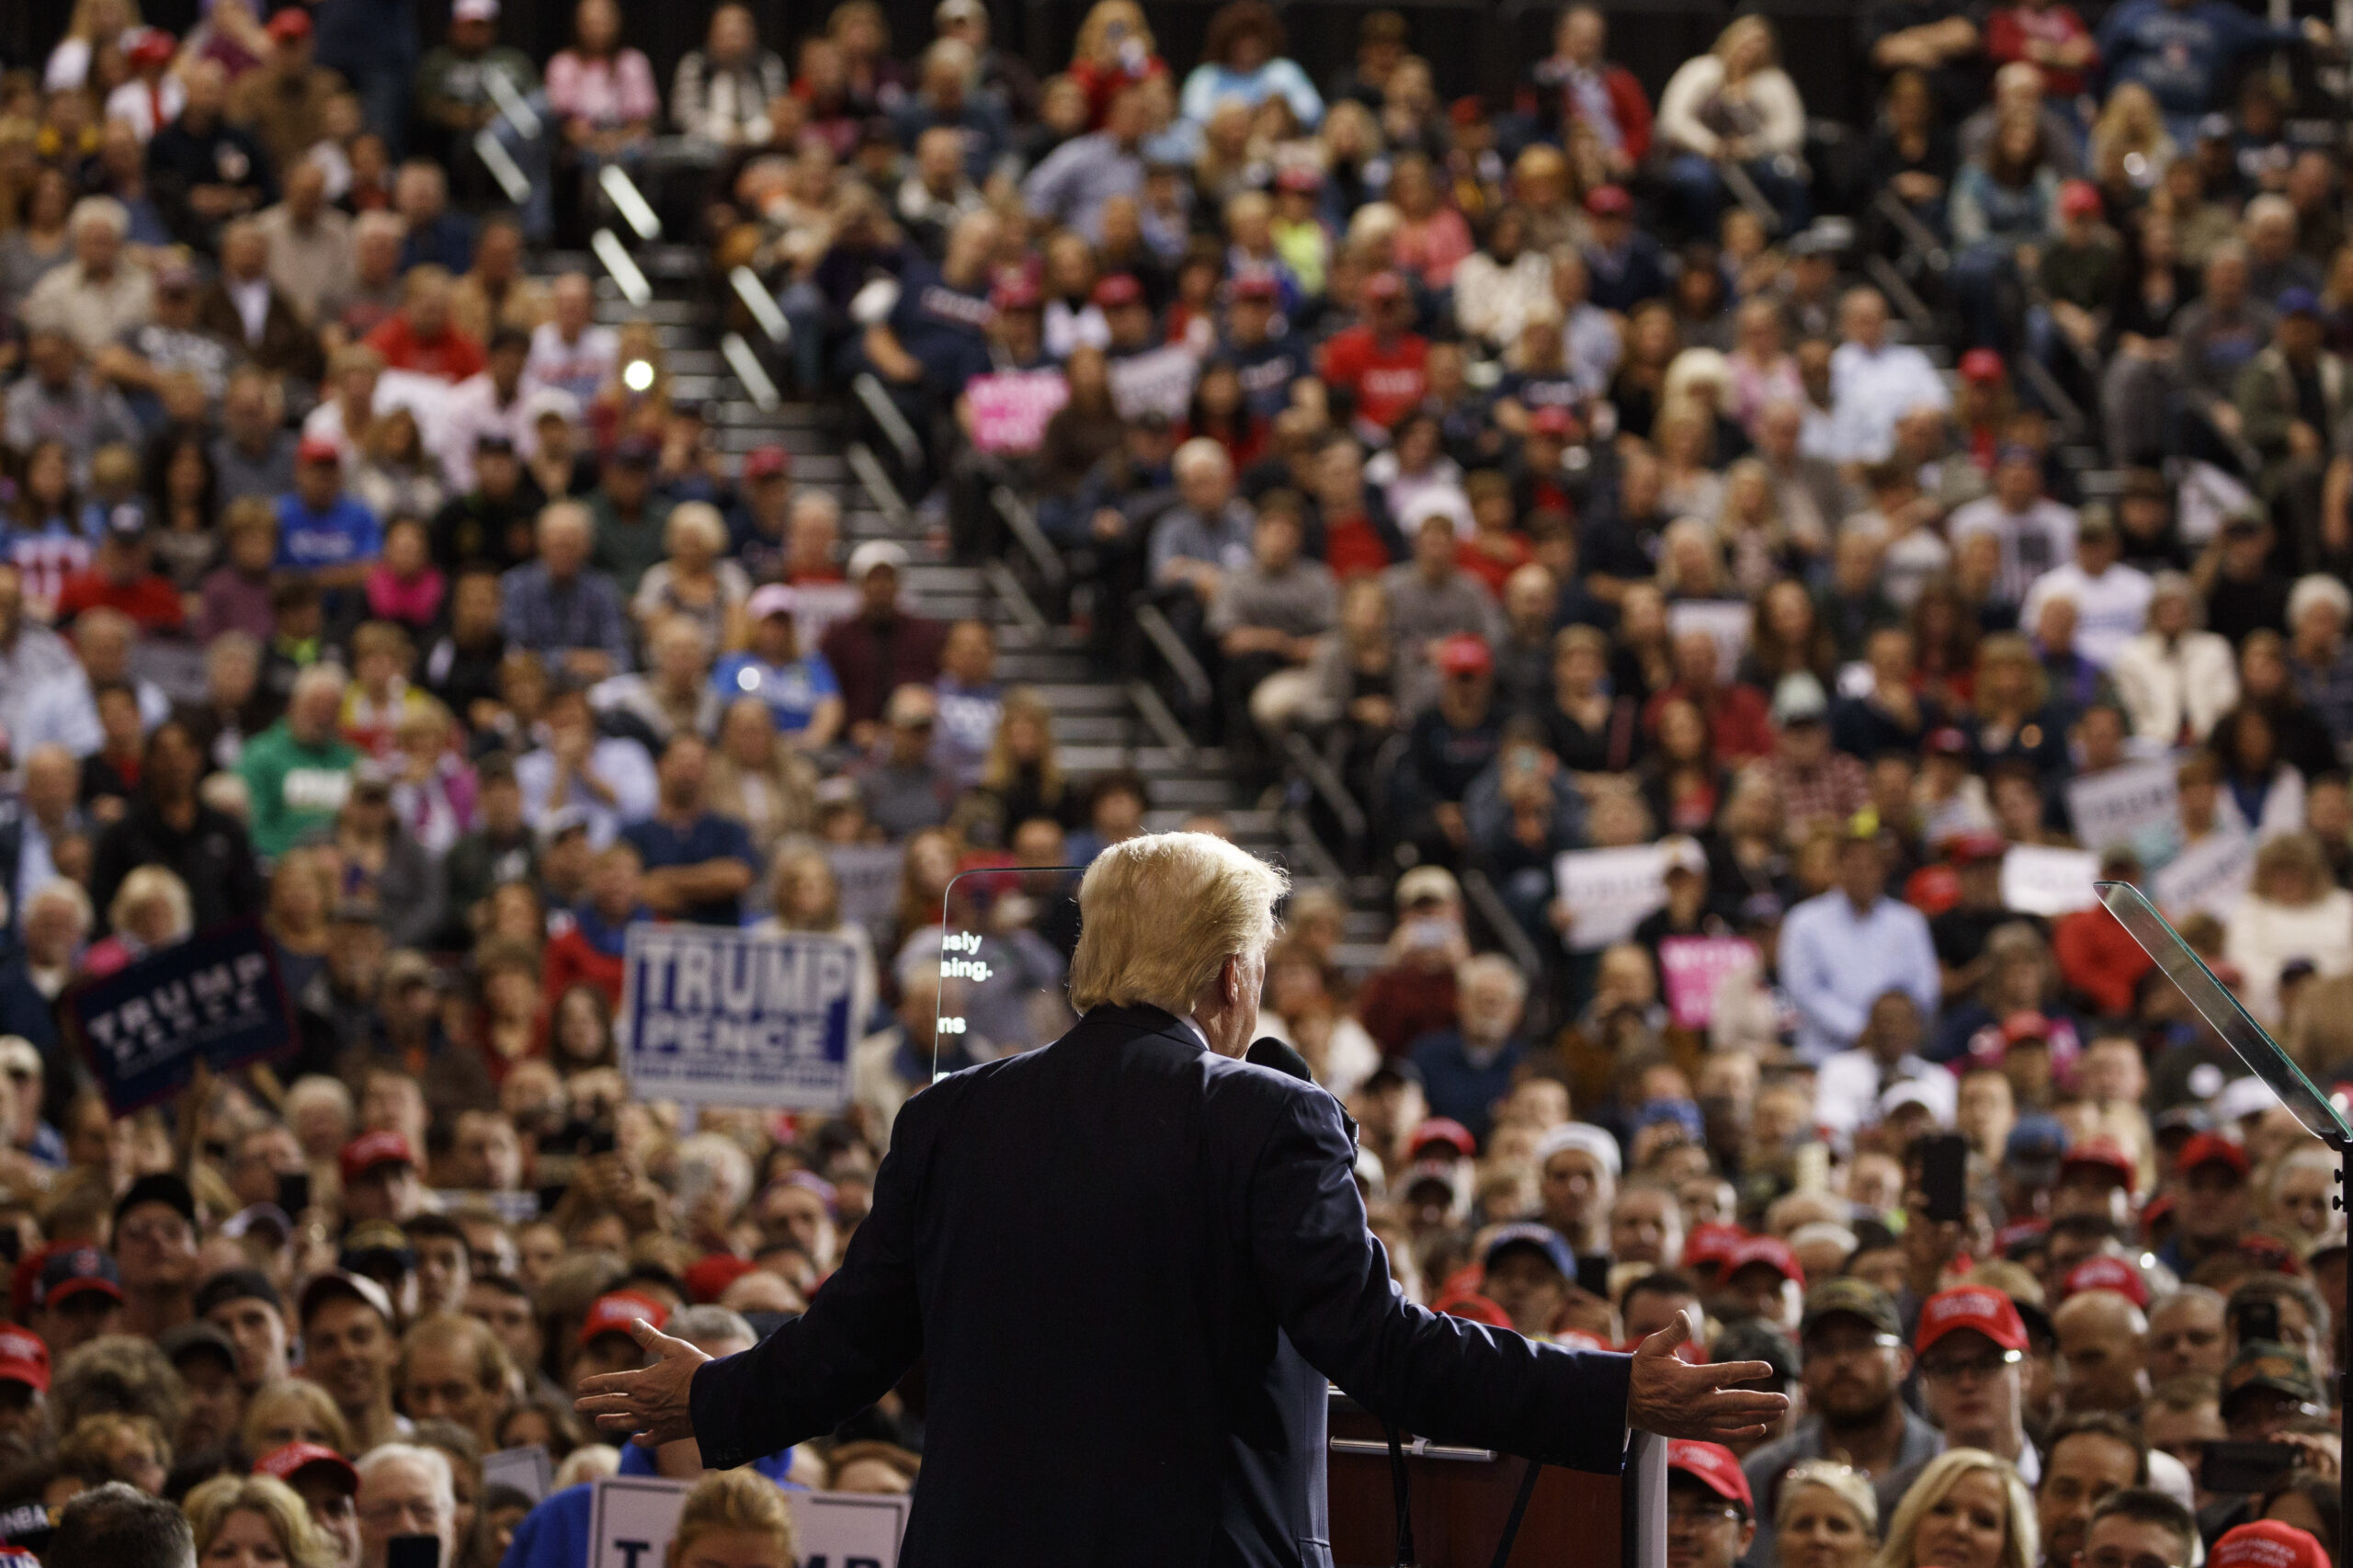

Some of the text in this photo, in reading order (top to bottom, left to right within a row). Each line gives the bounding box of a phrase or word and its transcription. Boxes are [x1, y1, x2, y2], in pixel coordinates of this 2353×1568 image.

[87, 951, 267, 1049] TRUMP
[641, 940, 850, 1011] TRUMP
[642, 1015, 825, 1058] PENCE
